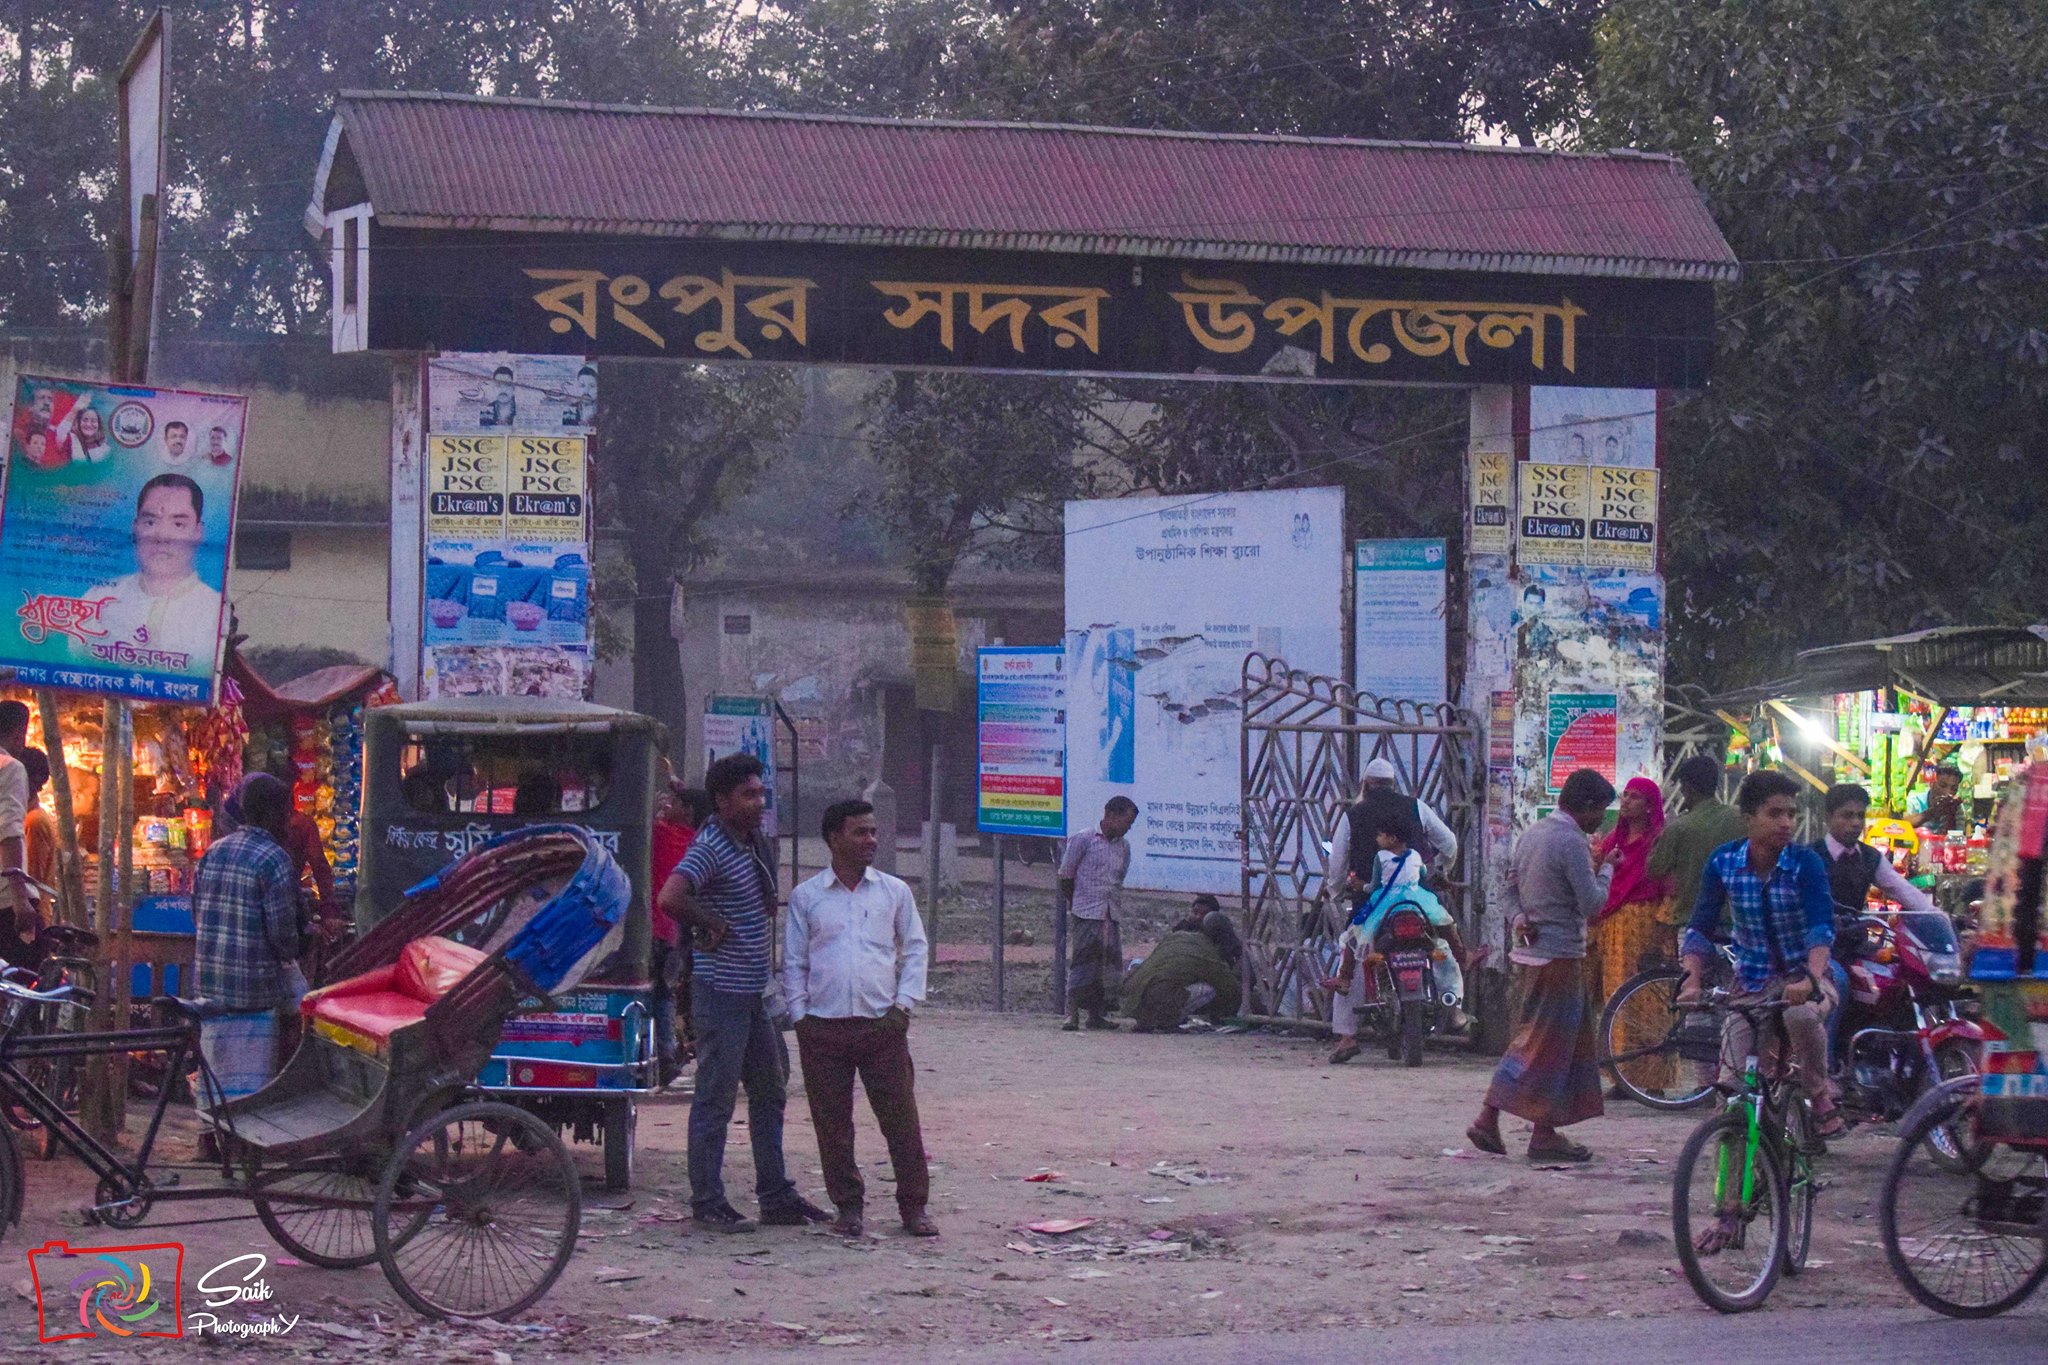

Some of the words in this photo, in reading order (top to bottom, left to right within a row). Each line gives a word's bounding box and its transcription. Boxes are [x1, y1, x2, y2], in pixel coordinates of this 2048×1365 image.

[521, 267, 818, 359] রংপুর
[870, 281, 1111, 354] সদর
[1168, 268, 1588, 374] উপজেলা
[442, 438, 494, 455] SSC
[521, 439, 571, 455] SSC
[441, 457, 493, 473] JSC
[520, 457, 571, 474] JSC
[1532, 467, 1576, 482] SSC
[1602, 470, 1646, 486] SSC
[443, 475, 494, 491] PSC
[522, 476, 571, 492] PSC
[1531, 484, 1576, 499] JSC
[1601, 487, 1645, 503] JSC
[1532, 501, 1576, 516] PSC
[1602, 504, 1645, 520] PSC
[1135, 543, 1197, 562] উপানুষ্ঠানিক
[1200, 543, 1227, 558] শিক্ষা
[1232, 544, 1260, 560] ব্যুরো
[133, 624, 149, 643] ও
[92, 641, 190, 671] অভিনন্দন
[53, 670, 125, 693] স্বেচ্ছাসেবক
[163, 681, 199, 700] রংপুর
